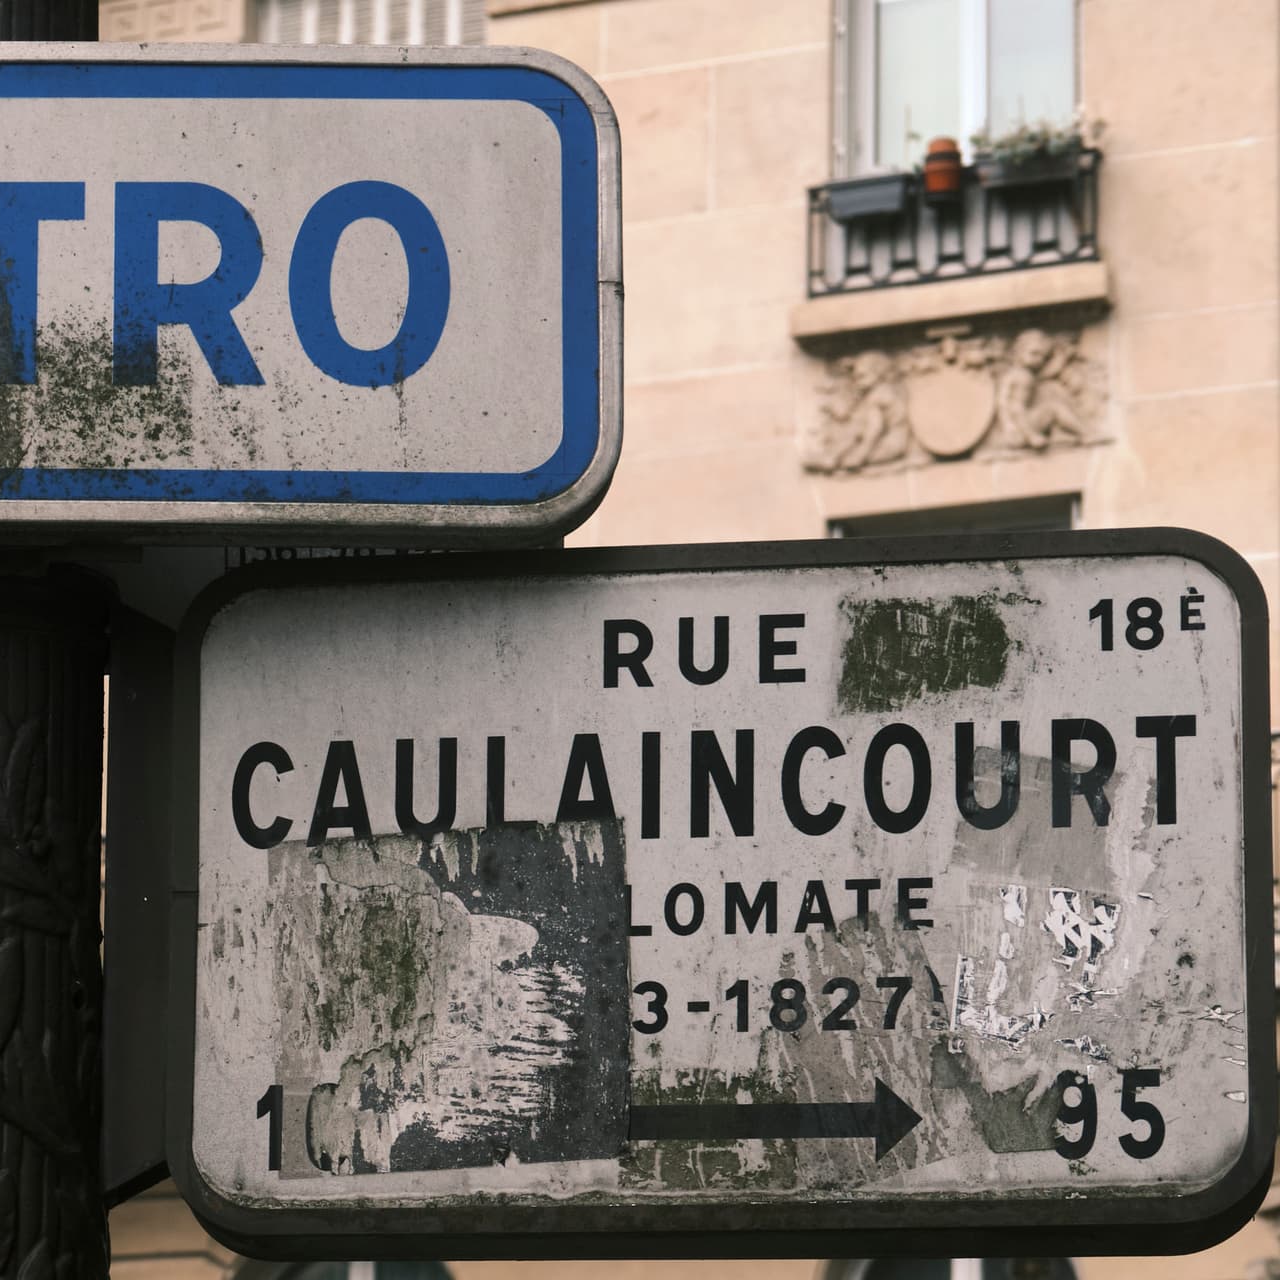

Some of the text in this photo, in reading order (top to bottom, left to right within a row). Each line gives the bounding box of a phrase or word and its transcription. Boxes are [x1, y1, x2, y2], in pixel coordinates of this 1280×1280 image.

[603, 613, 806, 689] RUE
[231, 714, 1197, 850] CAULAINCOURT
[624, 877, 934, 937] LOMATE
[1053, 1064, 1166, 1160] 95
